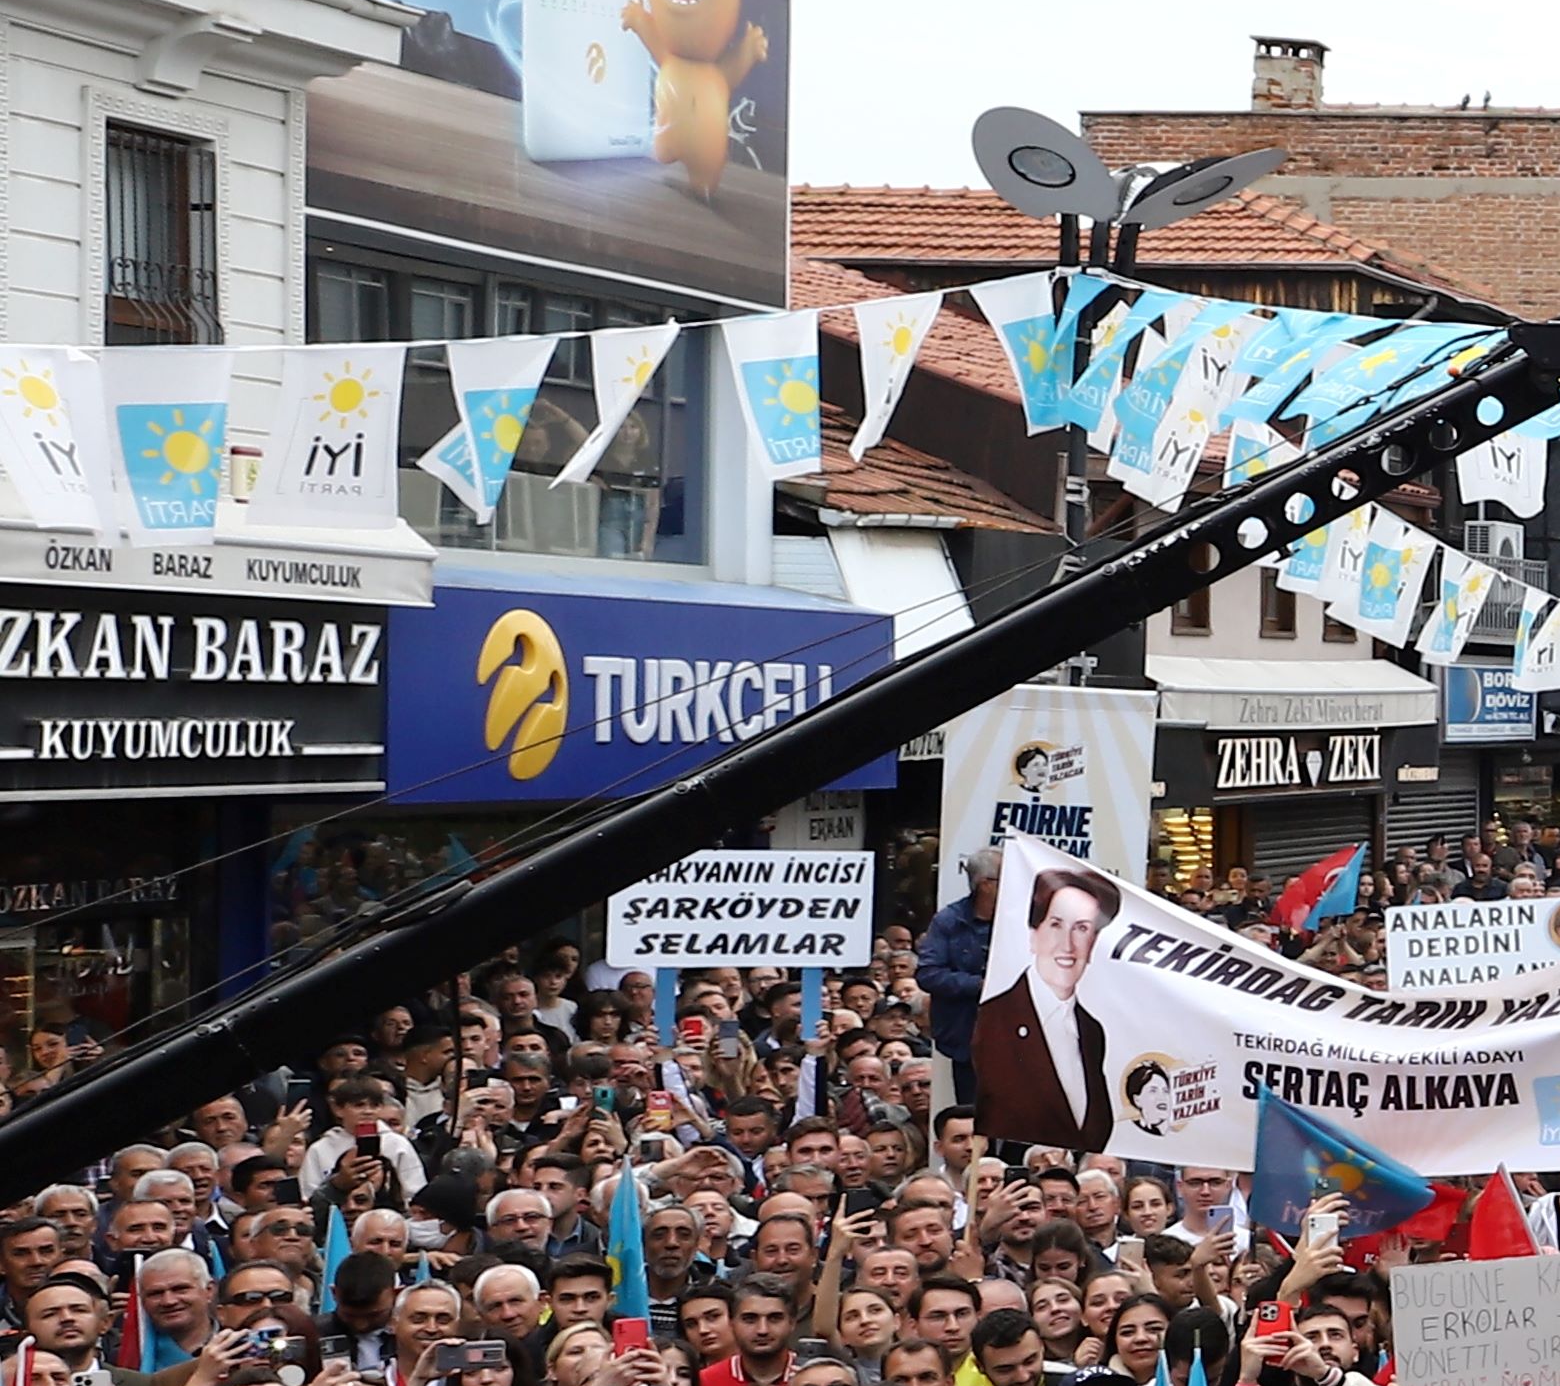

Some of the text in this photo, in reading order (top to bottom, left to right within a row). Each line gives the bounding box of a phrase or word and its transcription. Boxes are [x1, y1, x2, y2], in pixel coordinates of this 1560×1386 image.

[45, 540, 362, 589] ÖZKAN BARAZ KUYUMCULUK
[0, 609, 382, 685] ZKAN BARAZ
[38, 717, 295, 760] KUYUMCULUK
[1218, 736, 1301, 789] ZEHRA
[992, 796, 1093, 838] EDİRNE
[784, 857, 868, 885] İNCİSİ
[623, 892, 861, 925] ŞARKÖYDEN
[1391, 905, 1536, 932] ANALARIN
[635, 933, 846, 956] SELAMLAR
[1409, 929, 1522, 959] DERDİNİ
[1402, 965, 1500, 988] ANALAR
[1233, 1031, 1324, 1057] TEKİRDAĞ
[1464, 1050, 1524, 1065] ADAYI
[1381, 1072, 1520, 1111] ALKAYA
